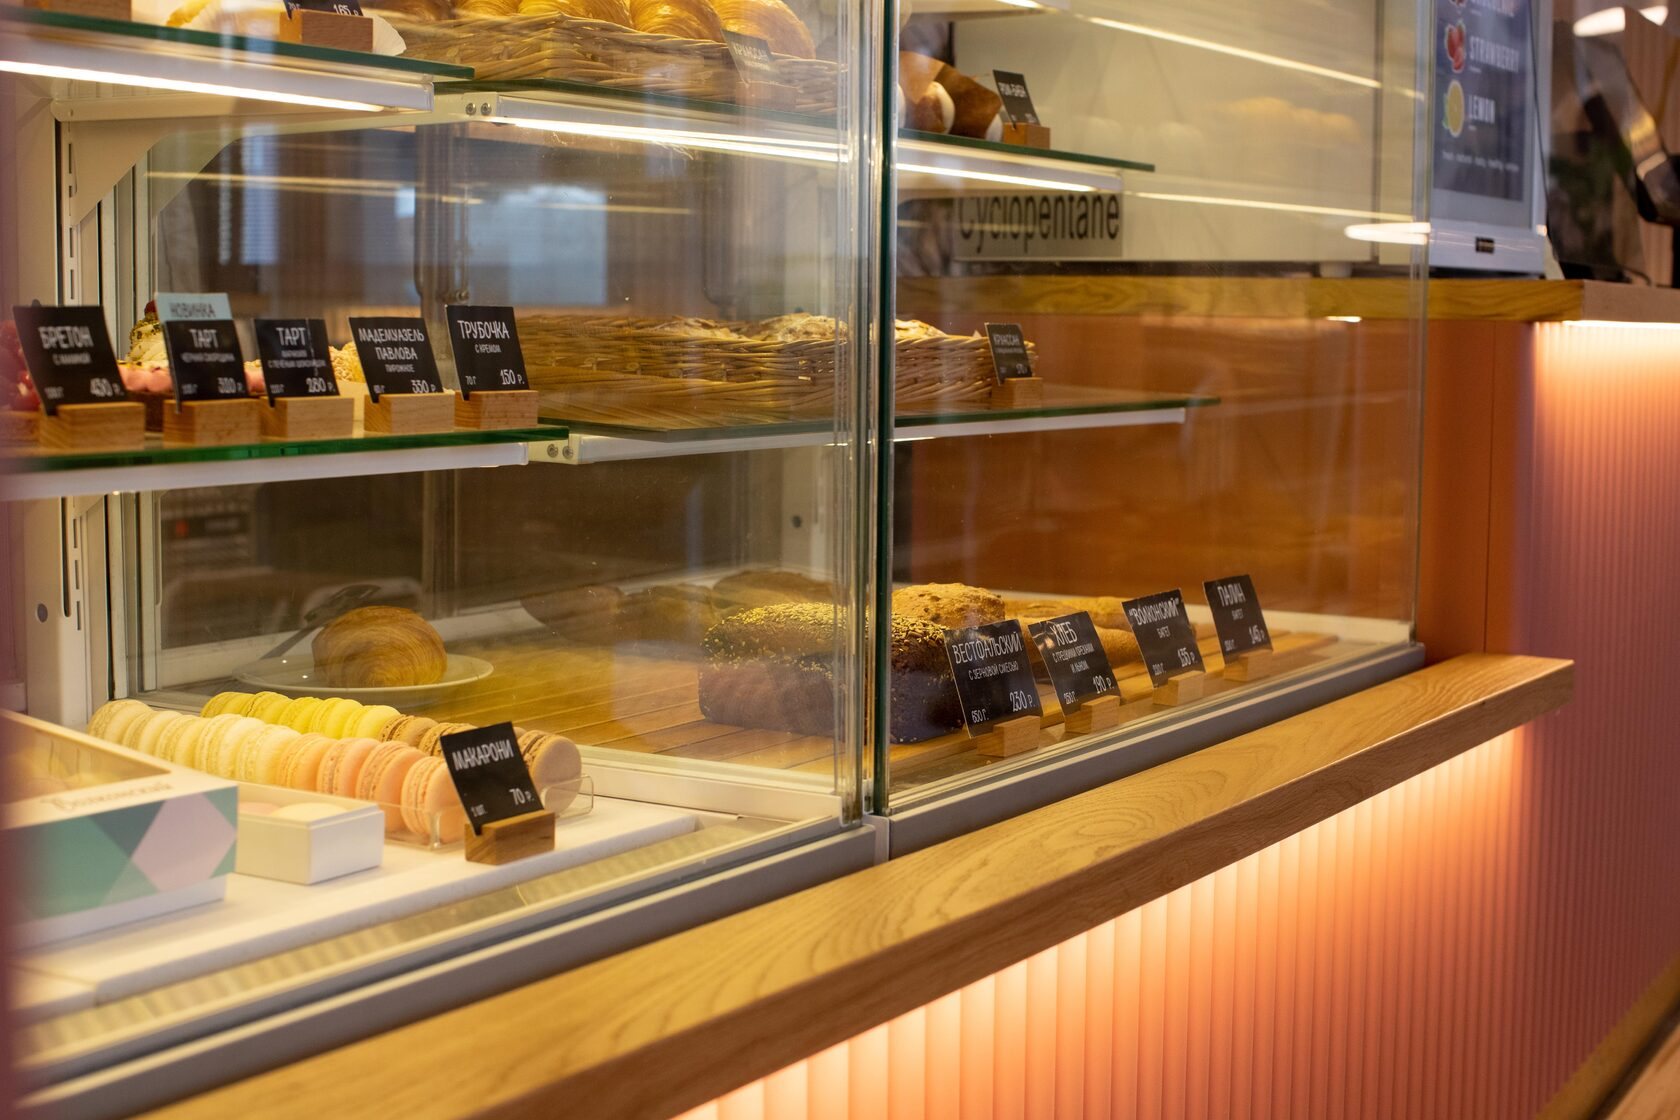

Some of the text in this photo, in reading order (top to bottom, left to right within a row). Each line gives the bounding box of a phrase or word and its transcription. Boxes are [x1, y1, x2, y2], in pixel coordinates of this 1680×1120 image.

[1469, 35, 1520, 73] STRAWBERRY
[1467, 95, 1495, 124] LEMON
[959, 194, 1120, 254] Cyclopentane
[168, 302, 217, 318] НОВИНКА
[38, 325, 95, 349] БРЕТОН
[189, 328, 219, 348] ТАРТ
[275, 327, 306, 346] ТАРТ
[358, 327, 425, 343] МАДЕМУАЗЕЛЬ
[457, 320, 510, 339] ТРУБОЧКА
[375, 346, 419, 360] ПАВЛОВА
[500, 368, 516, 385] 150
[1049, 621, 1078, 647] ХЛЕБ
[952, 631, 1023, 664] ВЕСТФАЛЬСКИЙ
[973, 663, 1000, 680] ЗЕРНОВОЙ
[1092, 675, 1107, 694] 190
[1009, 690, 1028, 712] 230
[451, 739, 515, 771] МАКАРОНИ
[509, 788, 526, 806] 70
